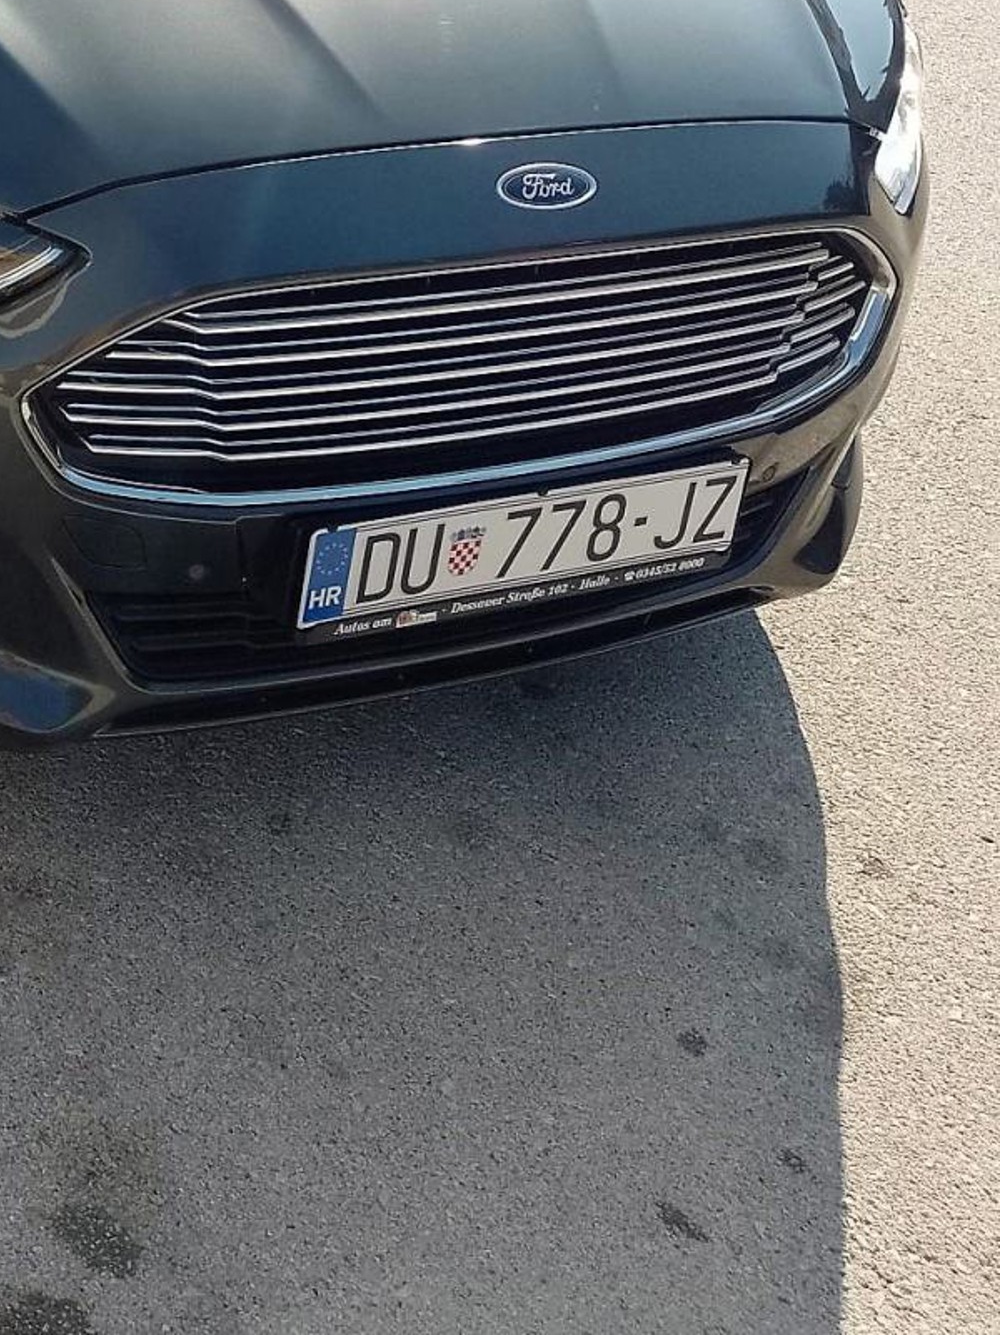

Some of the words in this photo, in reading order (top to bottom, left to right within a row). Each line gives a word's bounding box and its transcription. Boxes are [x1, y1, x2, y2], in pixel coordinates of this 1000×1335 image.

[522, 173, 575, 199] Ford
[355, 523, 446, 605] DU
[494, 476, 737, 580] 778-JZ
[308, 585, 342, 610] HR
[334, 620, 370, 636] Autos
